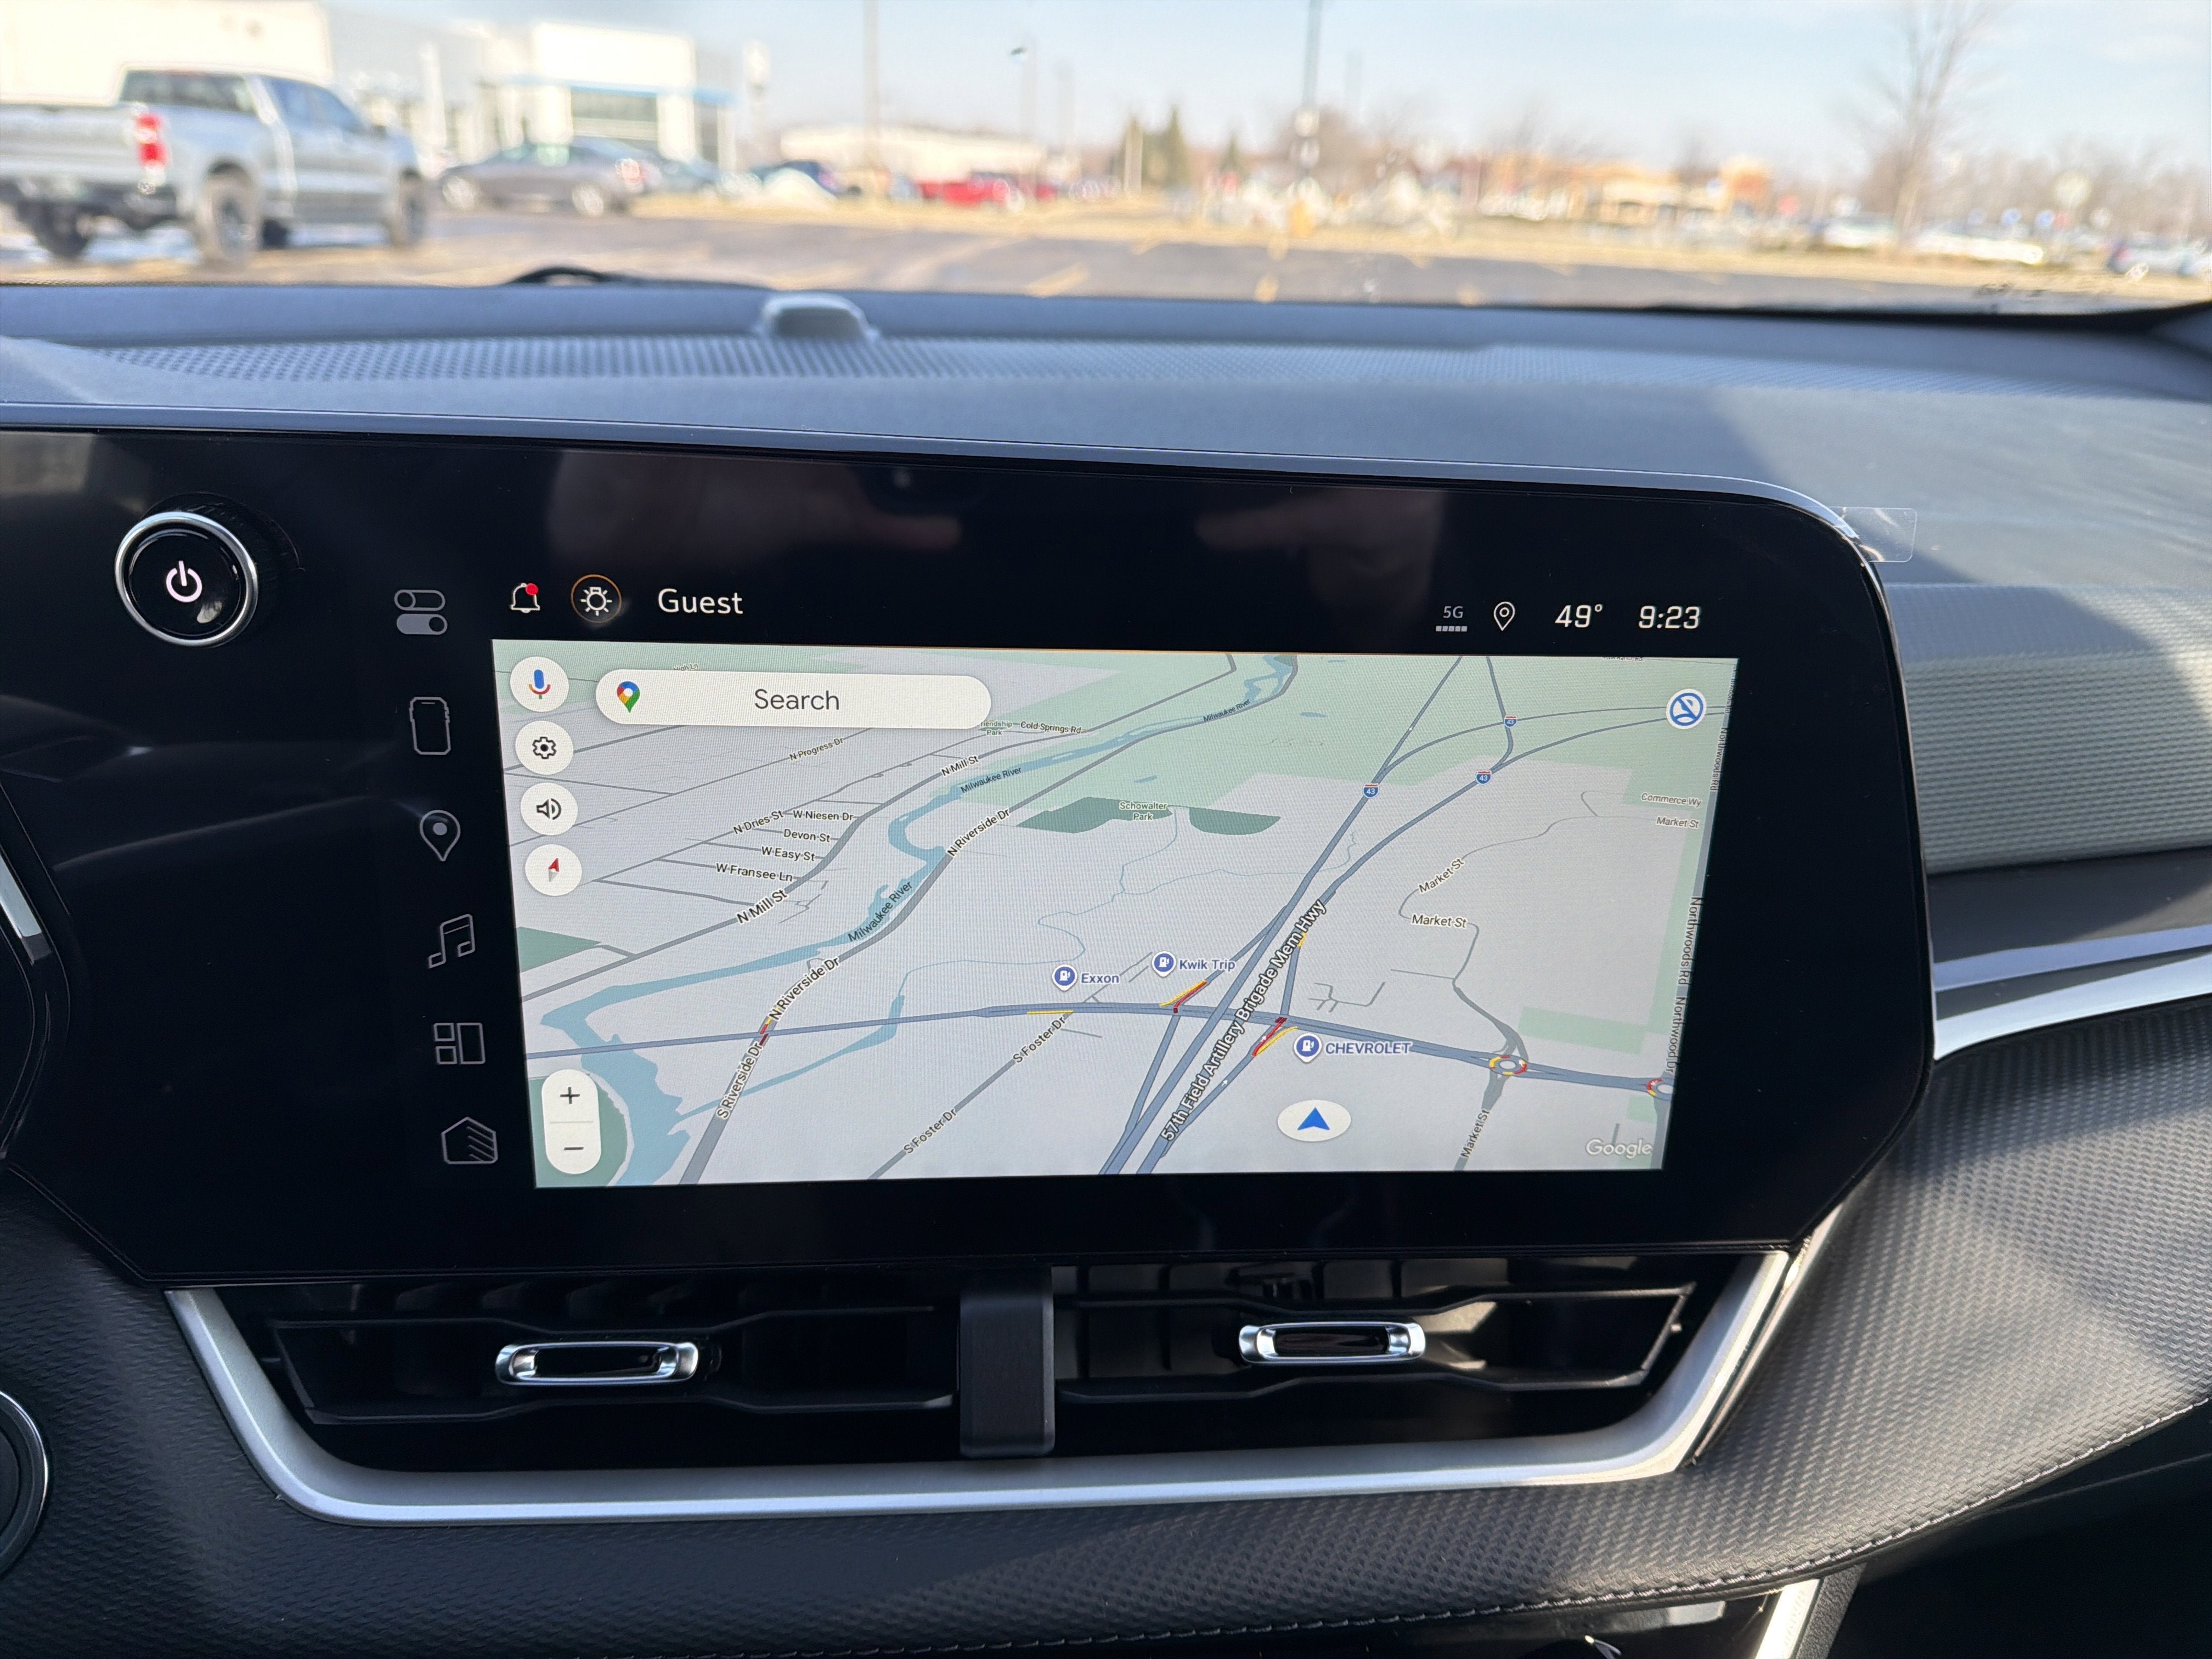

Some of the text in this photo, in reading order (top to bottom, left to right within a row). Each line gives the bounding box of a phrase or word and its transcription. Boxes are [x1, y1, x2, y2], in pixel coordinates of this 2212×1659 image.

[658, 588, 744, 615] Guest
[1443, 606, 1463, 619] 5G
[1554, 604, 1603, 628] 49°
[1638, 606, 1700, 630] 9:23
[754, 688, 839, 710] Search
[1203, 698, 1251, 723] Milwaukee River
[1020, 721, 1082, 734] Cold Springs Rd
[789, 753, 797, 761] N
[798, 742, 833, 758] Progress
[941, 755, 979, 776] N Mill St
[961, 767, 1022, 793] Milwaukee River
[1641, 793, 1702, 808] Commerce Wy
[733, 810, 784, 834] N Dries St
[793, 810, 854, 821] W Niesen Dr
[1656, 816, 1700, 828] Market St
[783, 828, 831, 843] Devon St
[947, 808, 1009, 856] N Riverside Dr
[761, 846, 815, 861] W Easy St
[716, 862, 793, 882] W Fransee Ln
[1419, 859, 1464, 893] Market St
[736, 888, 788, 924] N Mill St
[847, 881, 912, 942] Milwaukee River
[1412, 914, 1467, 928] Market St
[1678, 896, 1703, 985] Northwoods Rd
[1180, 959, 1235, 971] Kwik Trip
[769, 957, 839, 1020] N Riverside Dr
[1081, 973, 1119, 984] Exxon
[1160, 899, 1327, 1141] 57th Field Artillery Brigade Mem Hwy
[1013, 1015, 1065, 1063] S Foster Dr
[1666, 997, 1687, 1073] Northwood Dr
[1325, 1042, 1411, 1054] CHEVROLET
[717, 1042, 763, 1119] S Riverside Dr
[904, 1108, 957, 1154] S Foster Dr
[1460, 1109, 1490, 1158] Market St
[1585, 1138, 1653, 1159] Google
